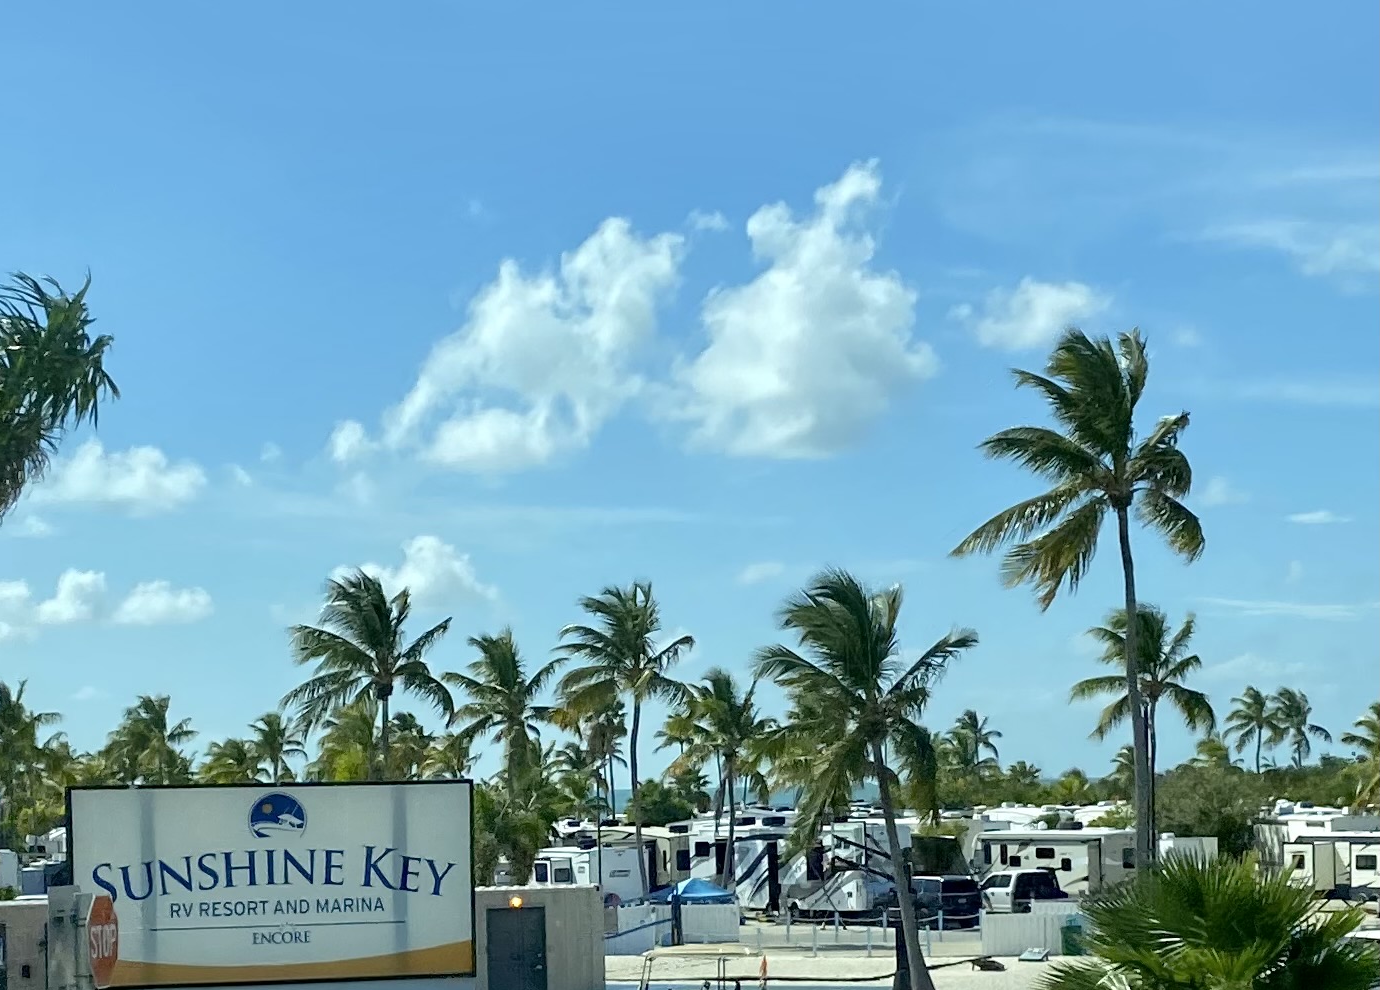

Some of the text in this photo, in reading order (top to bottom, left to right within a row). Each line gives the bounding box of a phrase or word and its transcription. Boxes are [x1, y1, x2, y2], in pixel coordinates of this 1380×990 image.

[92, 845, 457, 901] SUNSHINE KEY
[170, 897, 385, 919] RV RESORT AND MARINA
[90, 923, 117, 959] STOP
[252, 930, 312, 945] ENCORE
